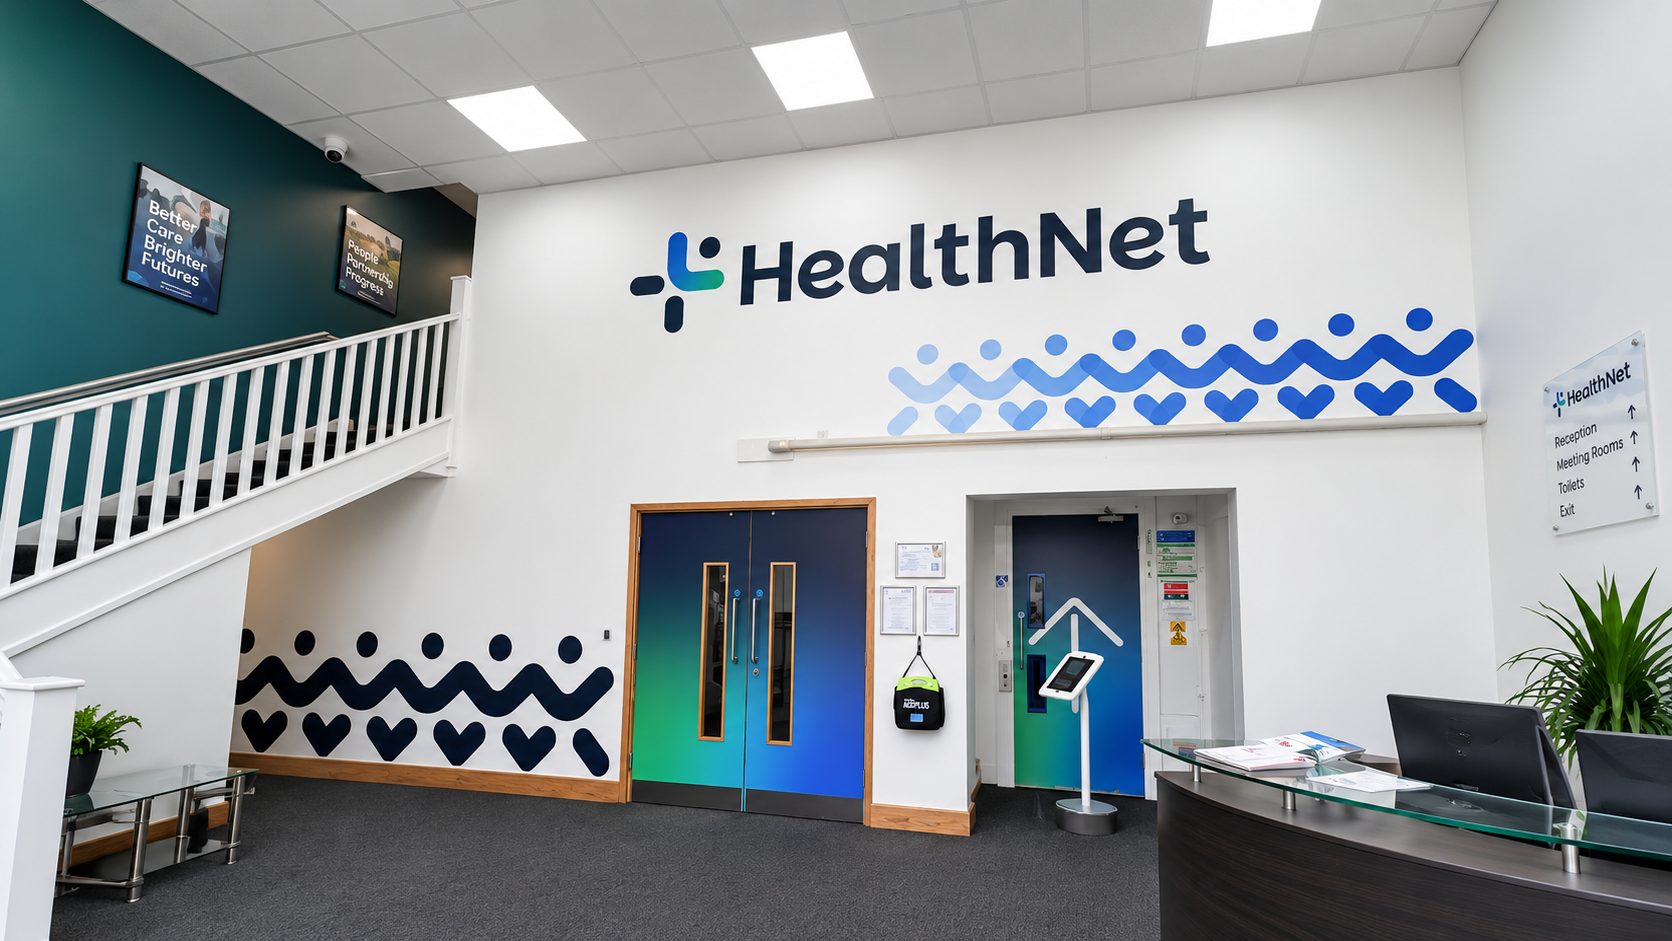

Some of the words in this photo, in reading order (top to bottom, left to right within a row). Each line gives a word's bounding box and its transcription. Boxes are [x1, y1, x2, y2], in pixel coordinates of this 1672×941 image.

[147, 218, 184, 245] Care
[149, 199, 197, 234] Better
[141, 251, 200, 287] Futures
[144, 234, 208, 273] Brighter
[740, 198, 1211, 306] HealthNet
[1567, 361, 1632, 407] HealthNet
[1554, 423, 1598, 448] Reception
[1556, 451, 1590, 472] Meeting
[1591, 439, 1624, 459] Rooms
[1558, 478, 1585, 495] Toilets
[1560, 503, 1576, 518] Exit
